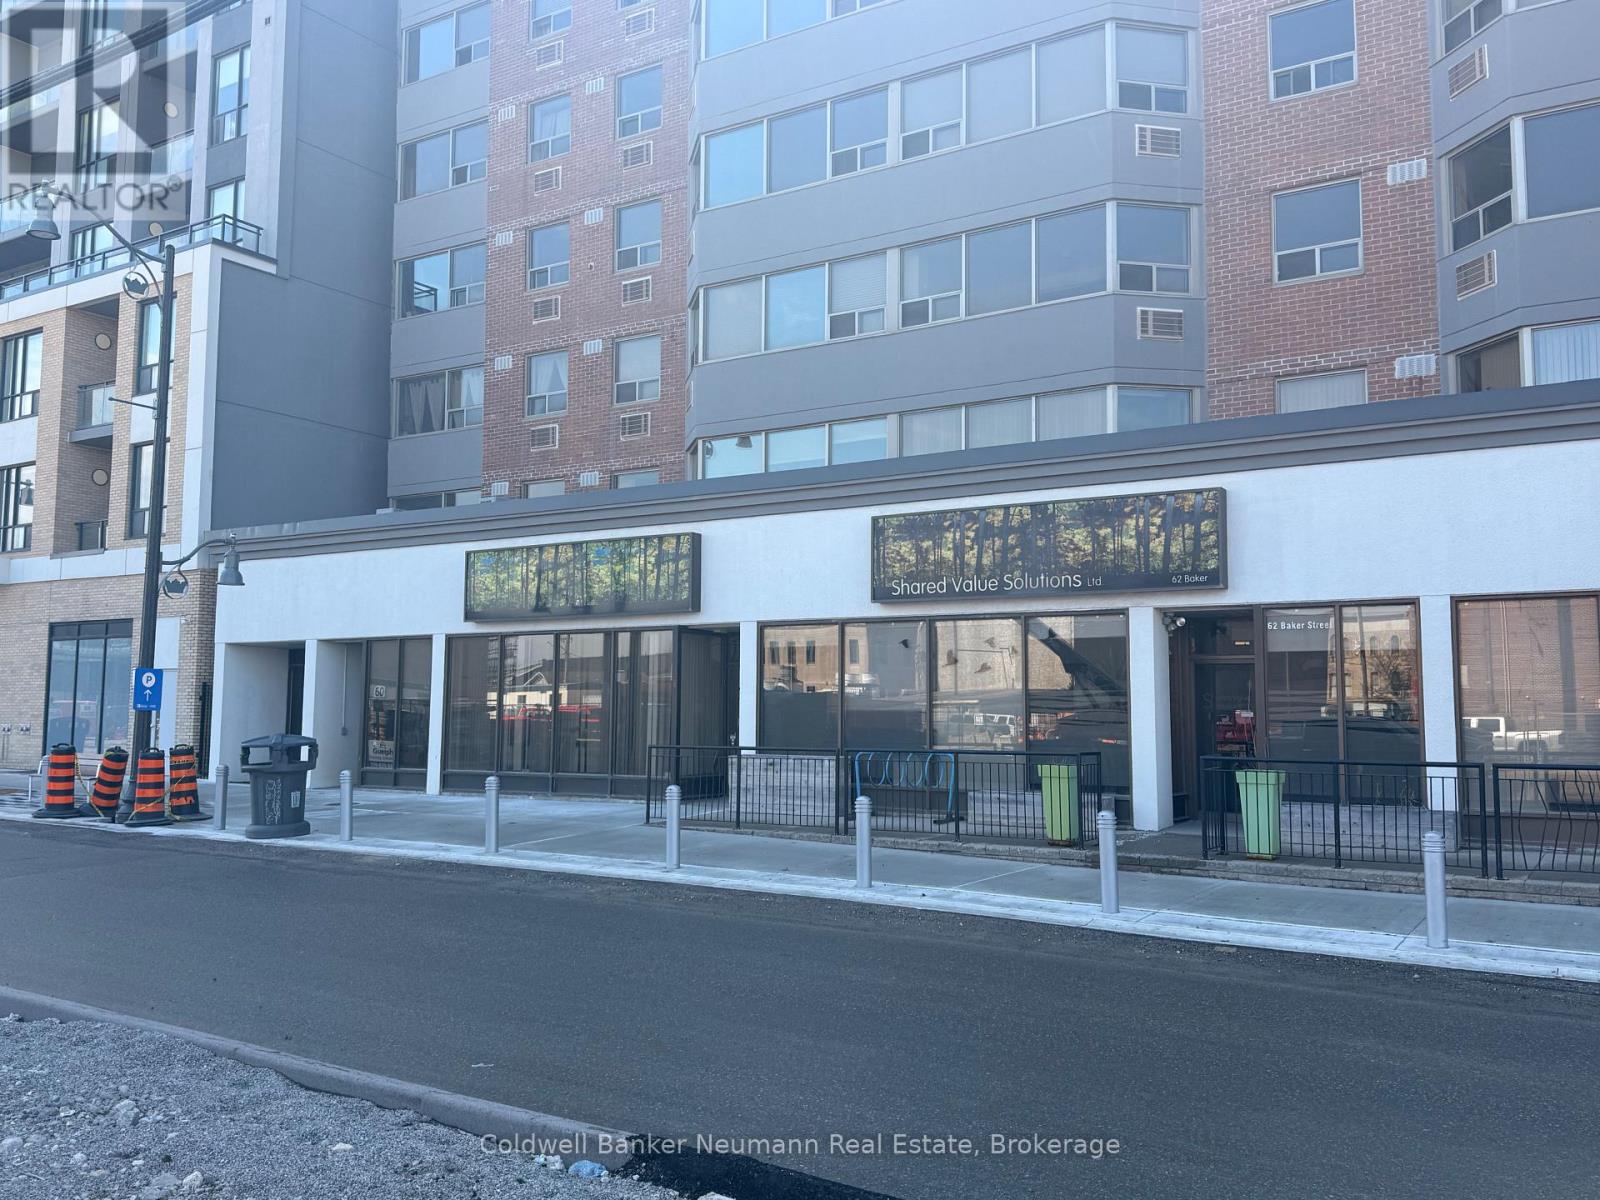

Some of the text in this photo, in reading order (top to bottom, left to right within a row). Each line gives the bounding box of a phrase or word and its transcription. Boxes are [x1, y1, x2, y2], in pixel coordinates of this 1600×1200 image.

[1171, 574, 1208, 583] 62 Baker
[891, 574, 1102, 596] Shared Value Solutions Ltd
[1267, 622, 1279, 630] 62
[1280, 621, 1305, 630] Baker
[146, 675, 153, 684] P
[374, 686, 385, 697] 60
